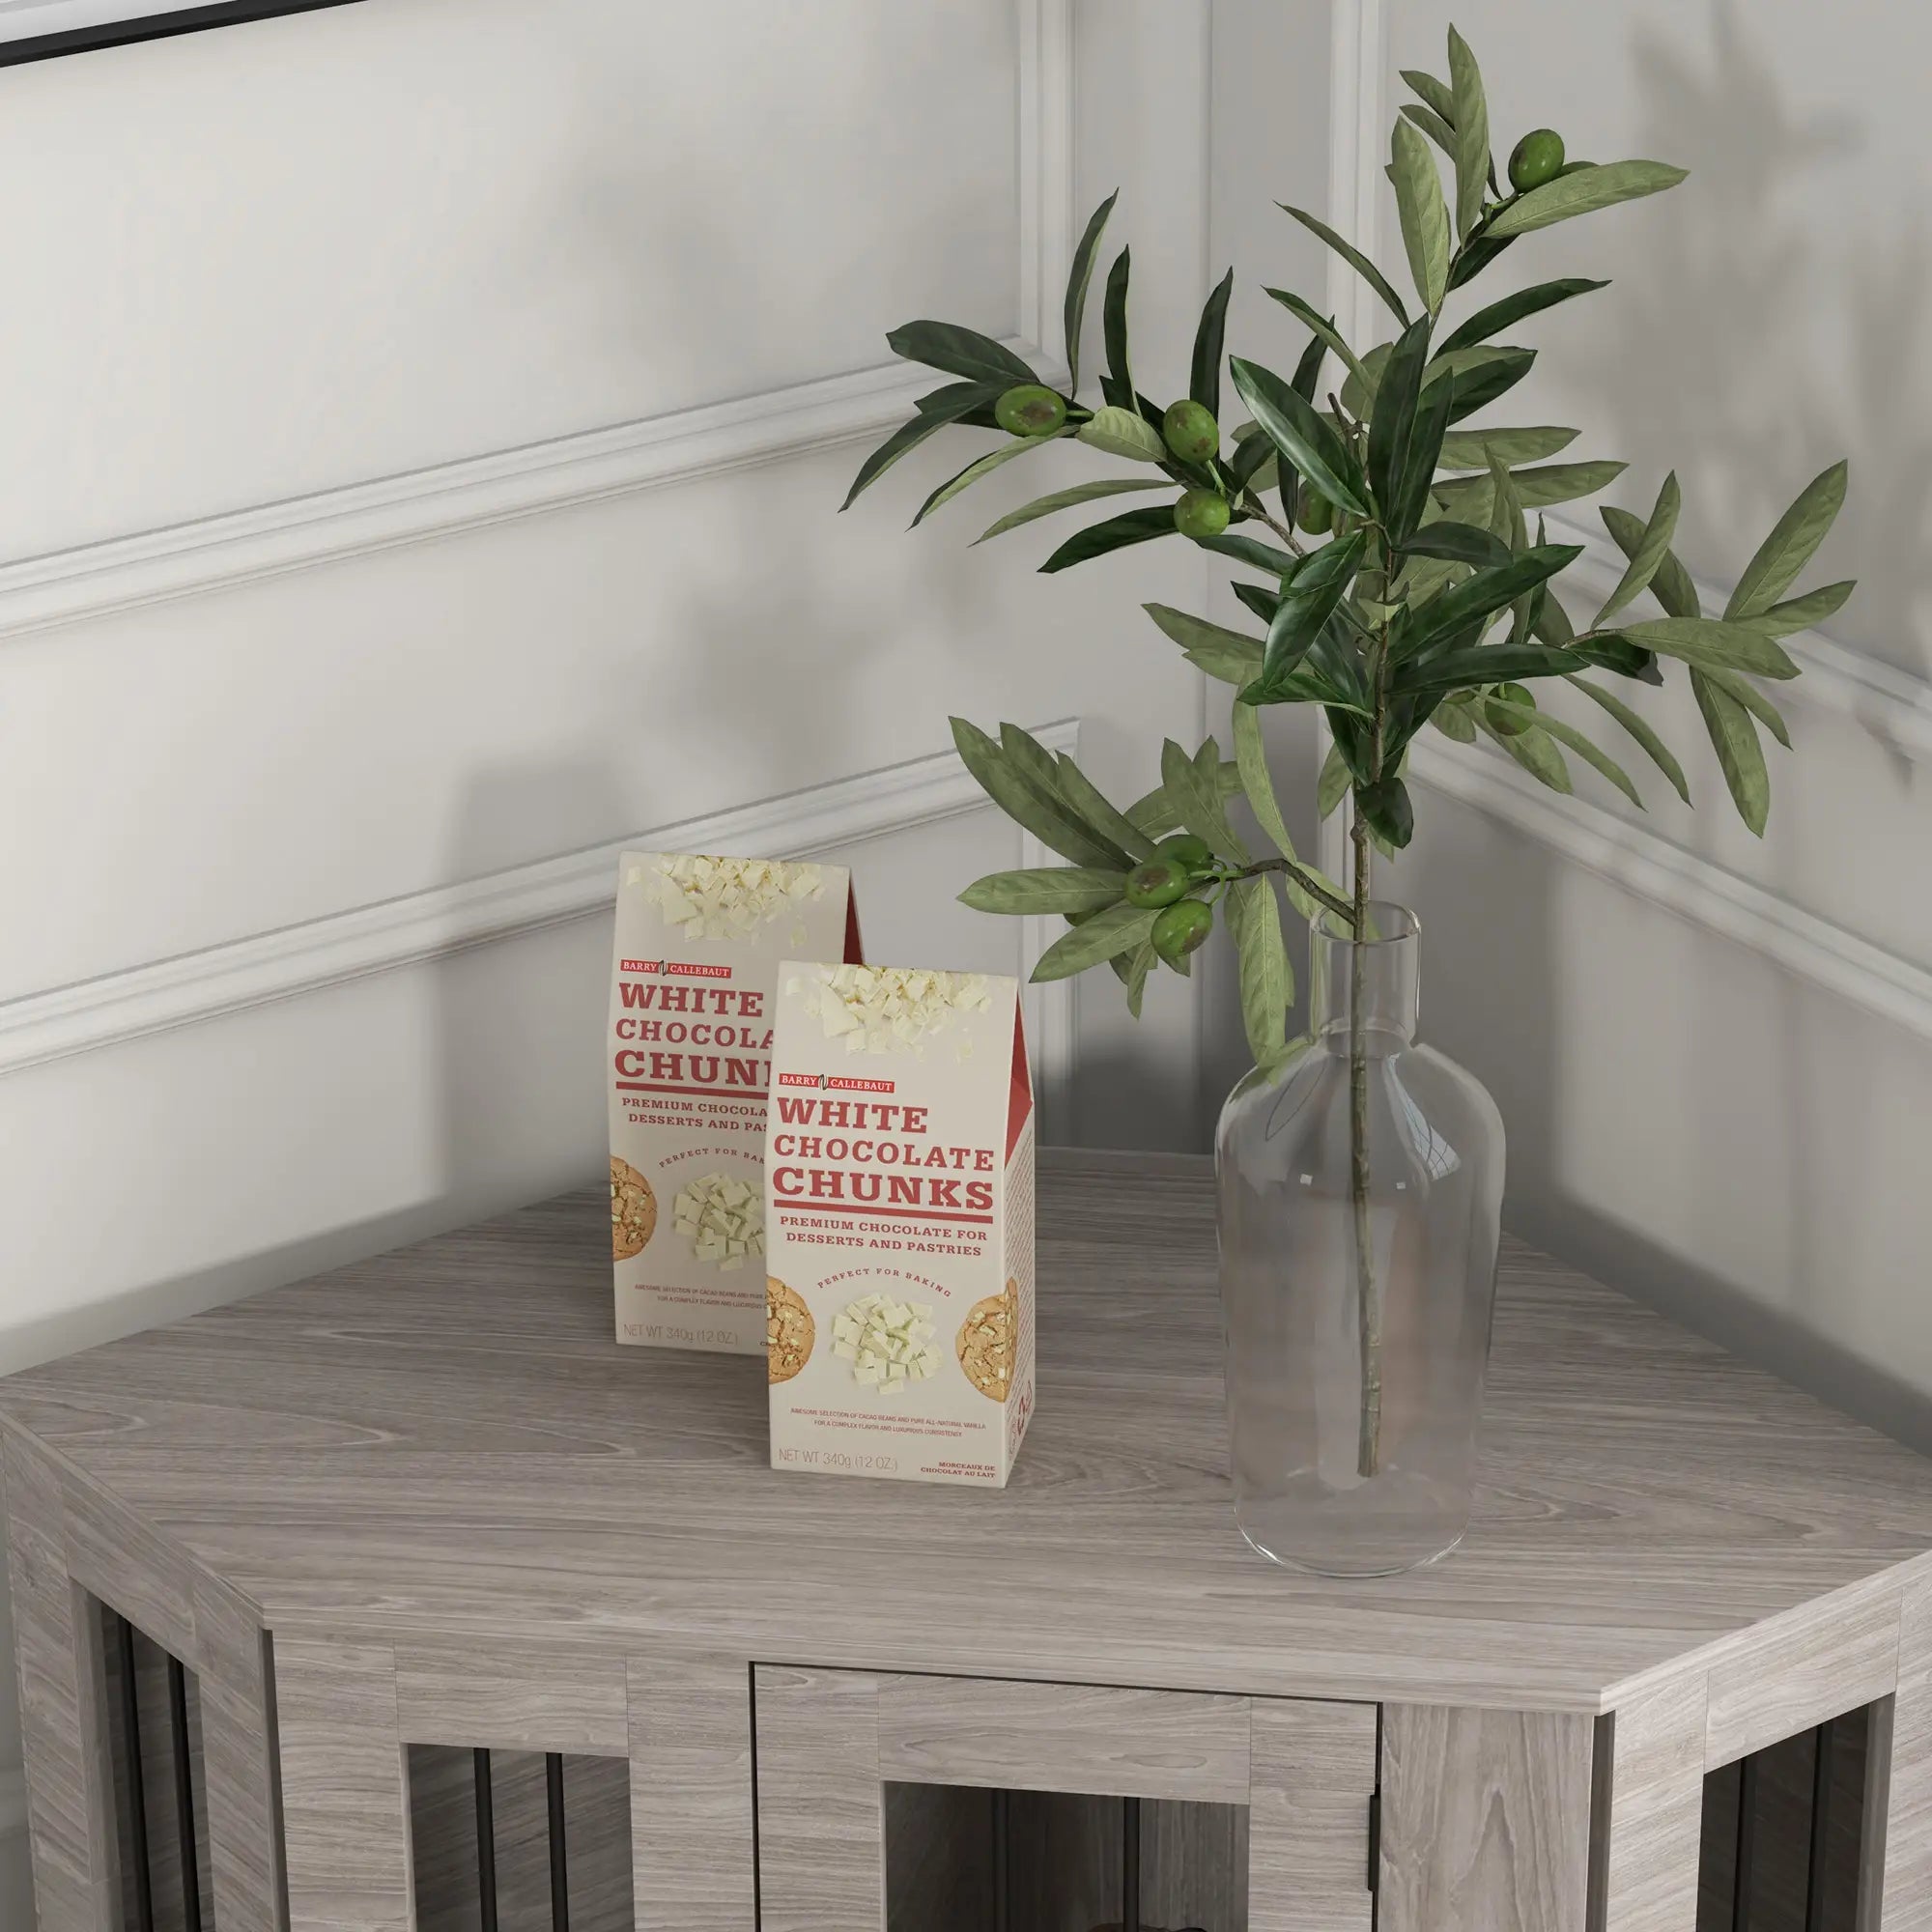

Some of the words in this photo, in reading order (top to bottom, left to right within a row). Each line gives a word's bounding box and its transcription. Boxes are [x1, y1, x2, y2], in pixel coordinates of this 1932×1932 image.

[623, 960, 657, 972] BARRY
[669, 965, 730, 977] CALLEBAUT
[619, 982, 763, 1017] WHITE
[614, 1049, 771, 1087] CHUN
[781, 1074, 817, 1086] BARRY
[830, 1079, 893, 1092] CALLEBAUT
[622, 1096, 693, 1111] PREMIUM
[629, 1114, 703, 1128] DESSERTS
[708, 1120, 739, 1131] AND
[778, 1097, 927, 1133] WHITE
[659, 1148, 709, 1168] PERFECT
[715, 1148, 737, 1156] FOR
[774, 1134, 994, 1171] CHOCOLATE
[773, 1167, 993, 1210] CHUNKS
[780, 1215, 854, 1231] PREMIUM
[859, 1222, 952, 1237] CHOCOLATE
[957, 1230, 987, 1241] FOR
[786, 1233, 864, 1247] DESSERTS
[869, 1239, 902, 1250] AND
[907, 1241, 981, 1256] PASTRIES
[817, 1268, 869, 1289] PERFECT
[876, 1268, 899, 1277] FOR
[905, 1272, 951, 1297] BAKING
[624, 1323, 642, 1337] NET
[646, 1325, 663, 1338] WT
[779, 1448, 799, 1462] NET
[803, 1451, 819, 1463] WT
[823, 1452, 851, 1468] 340g
[855, 1456, 872, 1468] (12
[939, 1462, 982, 1471] MORCEAUX
[921, 1466, 962, 1475] CHOCOLAT
